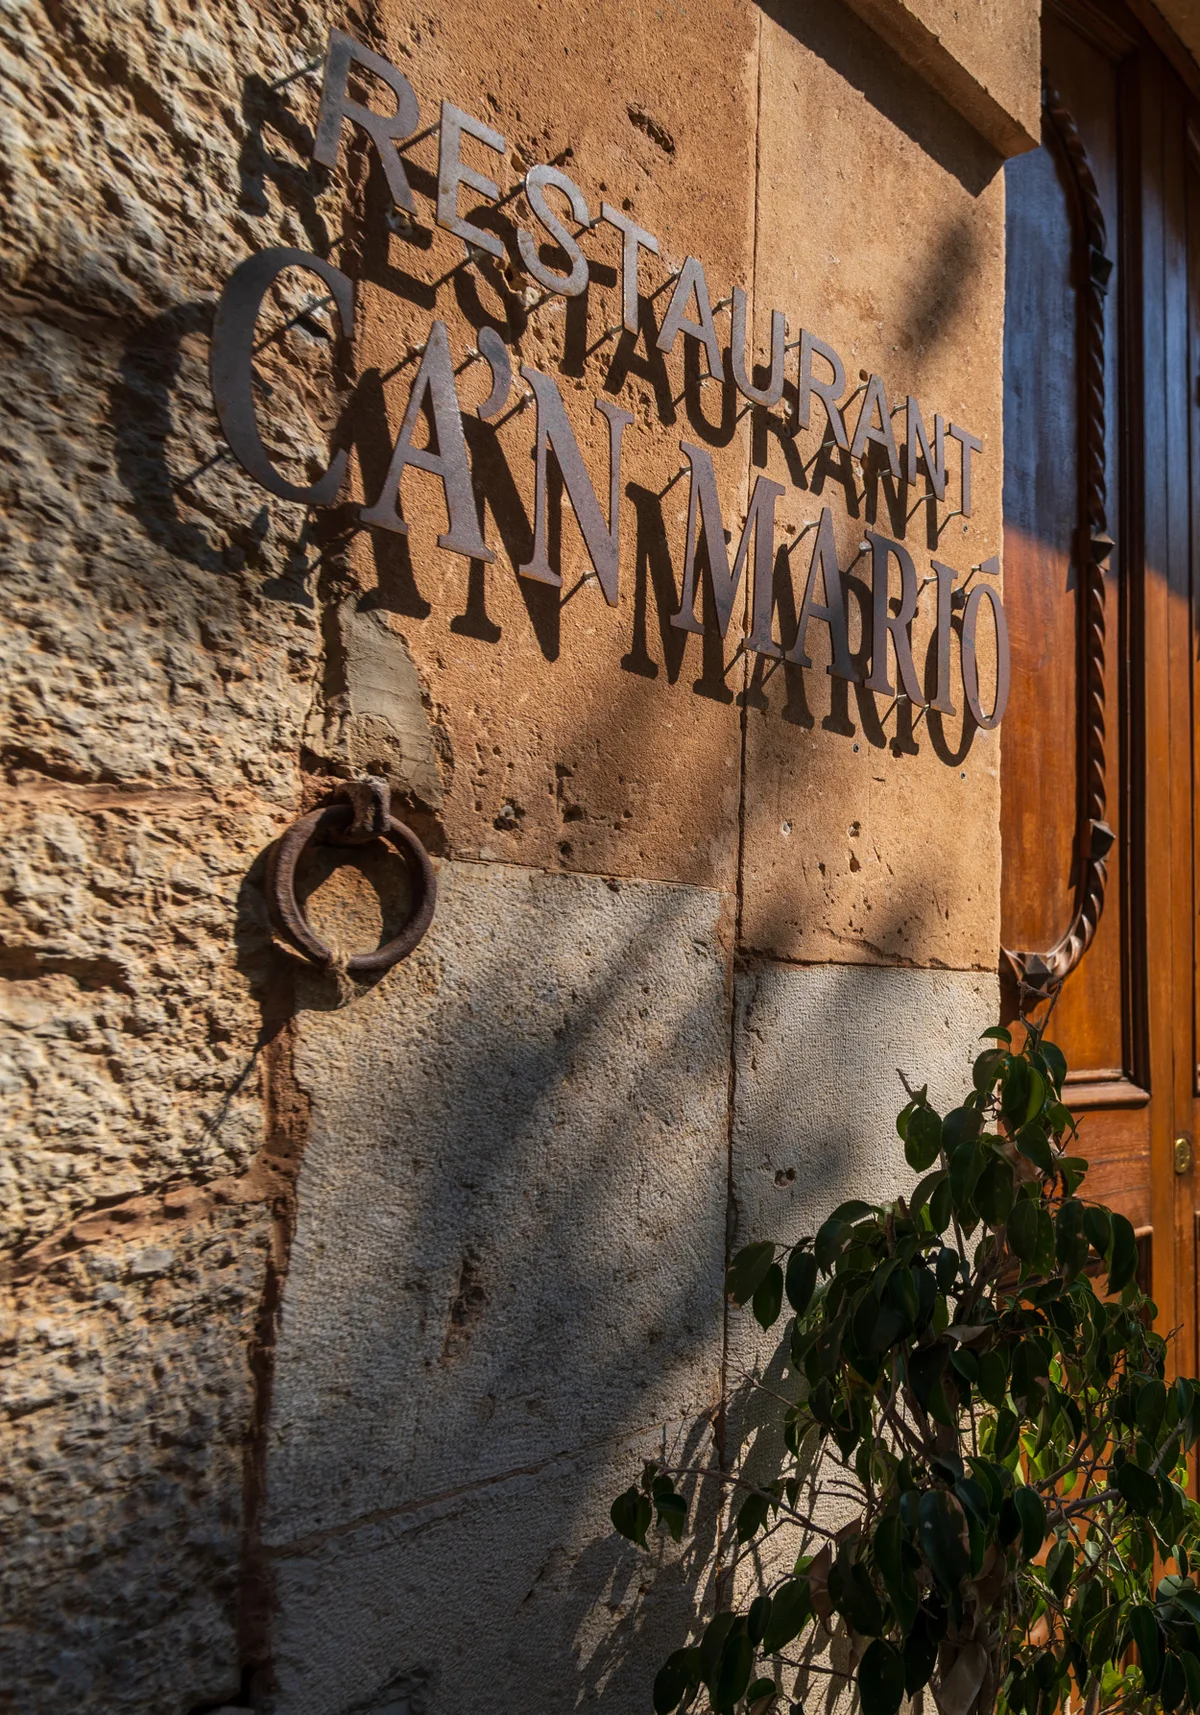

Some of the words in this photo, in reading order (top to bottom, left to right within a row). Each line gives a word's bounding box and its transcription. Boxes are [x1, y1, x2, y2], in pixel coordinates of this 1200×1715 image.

[211, 246, 634, 608] CA'N
[670, 440, 1010, 730] MARIÓ
[313, 27, 983, 518] RESTAURANT
